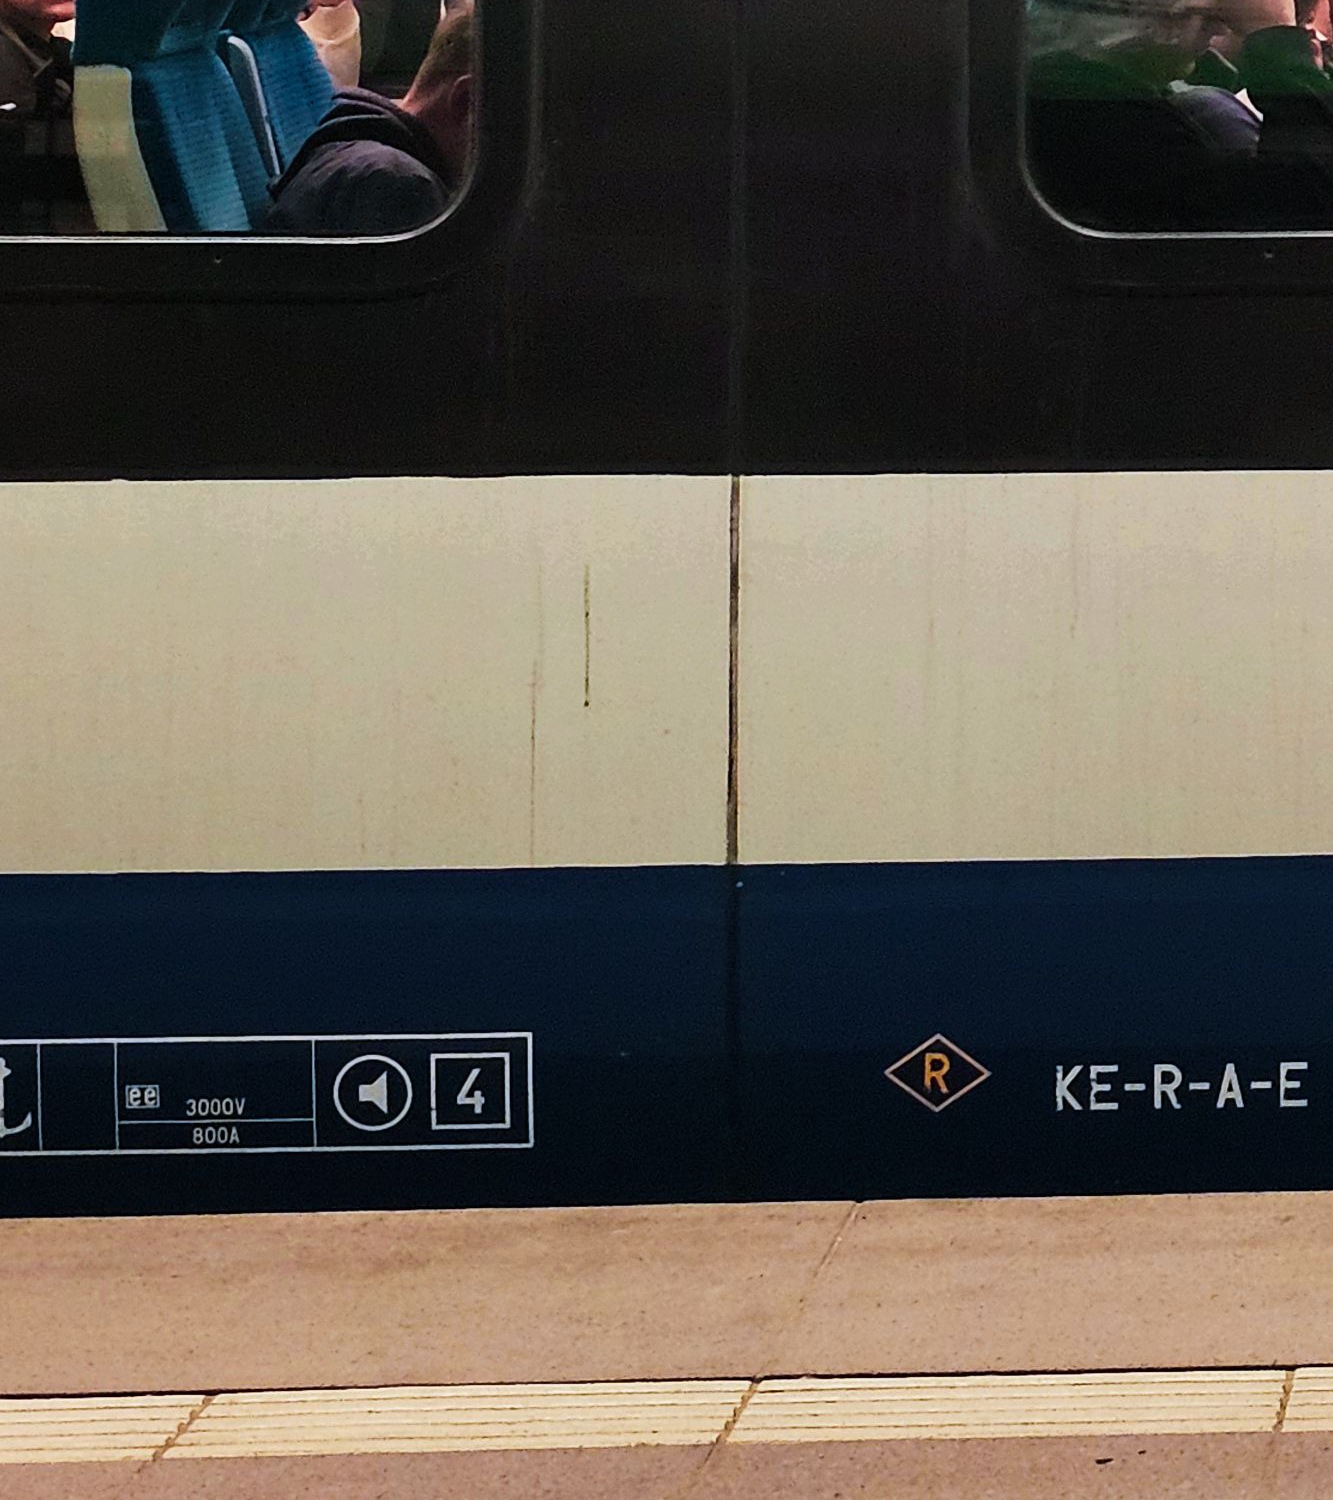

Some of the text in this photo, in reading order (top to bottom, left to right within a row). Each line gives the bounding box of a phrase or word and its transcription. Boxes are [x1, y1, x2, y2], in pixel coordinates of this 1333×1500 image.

[456, 1067, 486, 1114] 4
[923, 1052, 951, 1094] R
[1055, 1060, 1309, 1112] KE-R-A-E
[185, 1097, 246, 1117] 3000V
[192, 1126, 241, 1145] 800A
